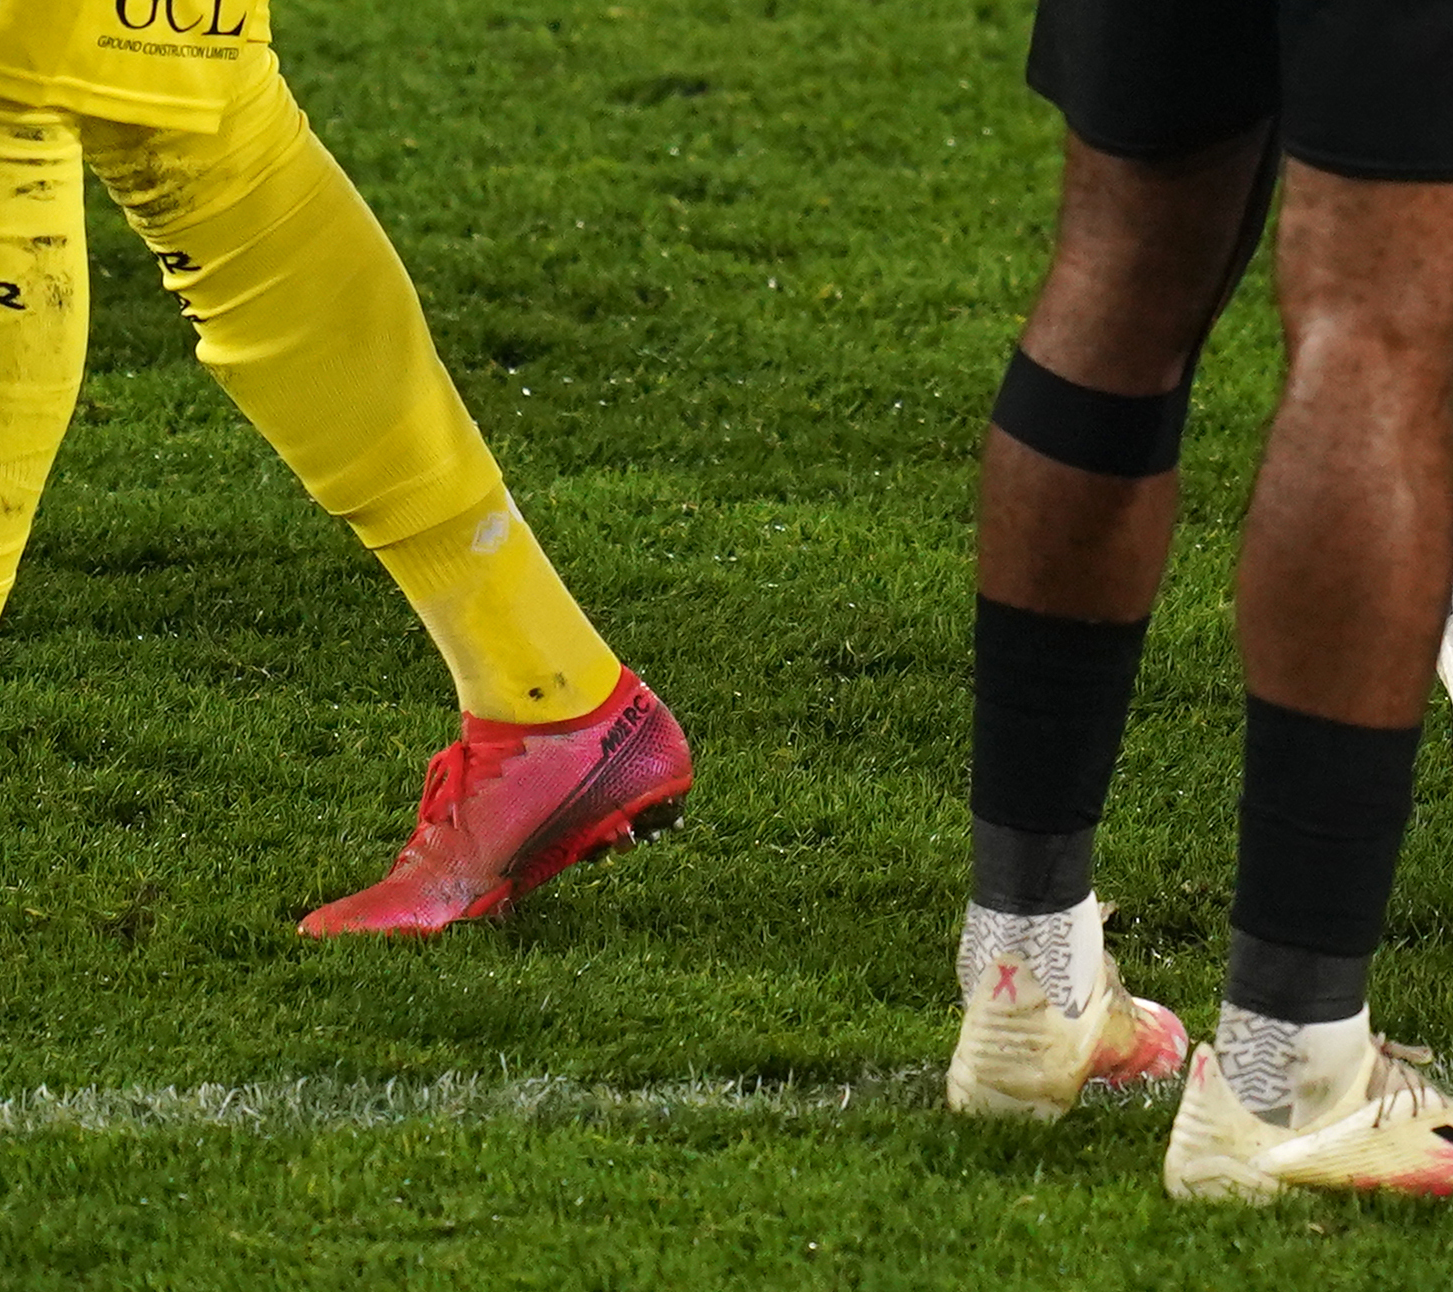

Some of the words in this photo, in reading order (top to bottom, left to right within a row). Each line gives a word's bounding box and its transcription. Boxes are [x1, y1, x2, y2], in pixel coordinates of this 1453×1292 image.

[97, 35, 142, 53] GROUND
[143, 42, 205, 58] CONSTRUCTION
[206, 46, 240, 60] LIMITED
